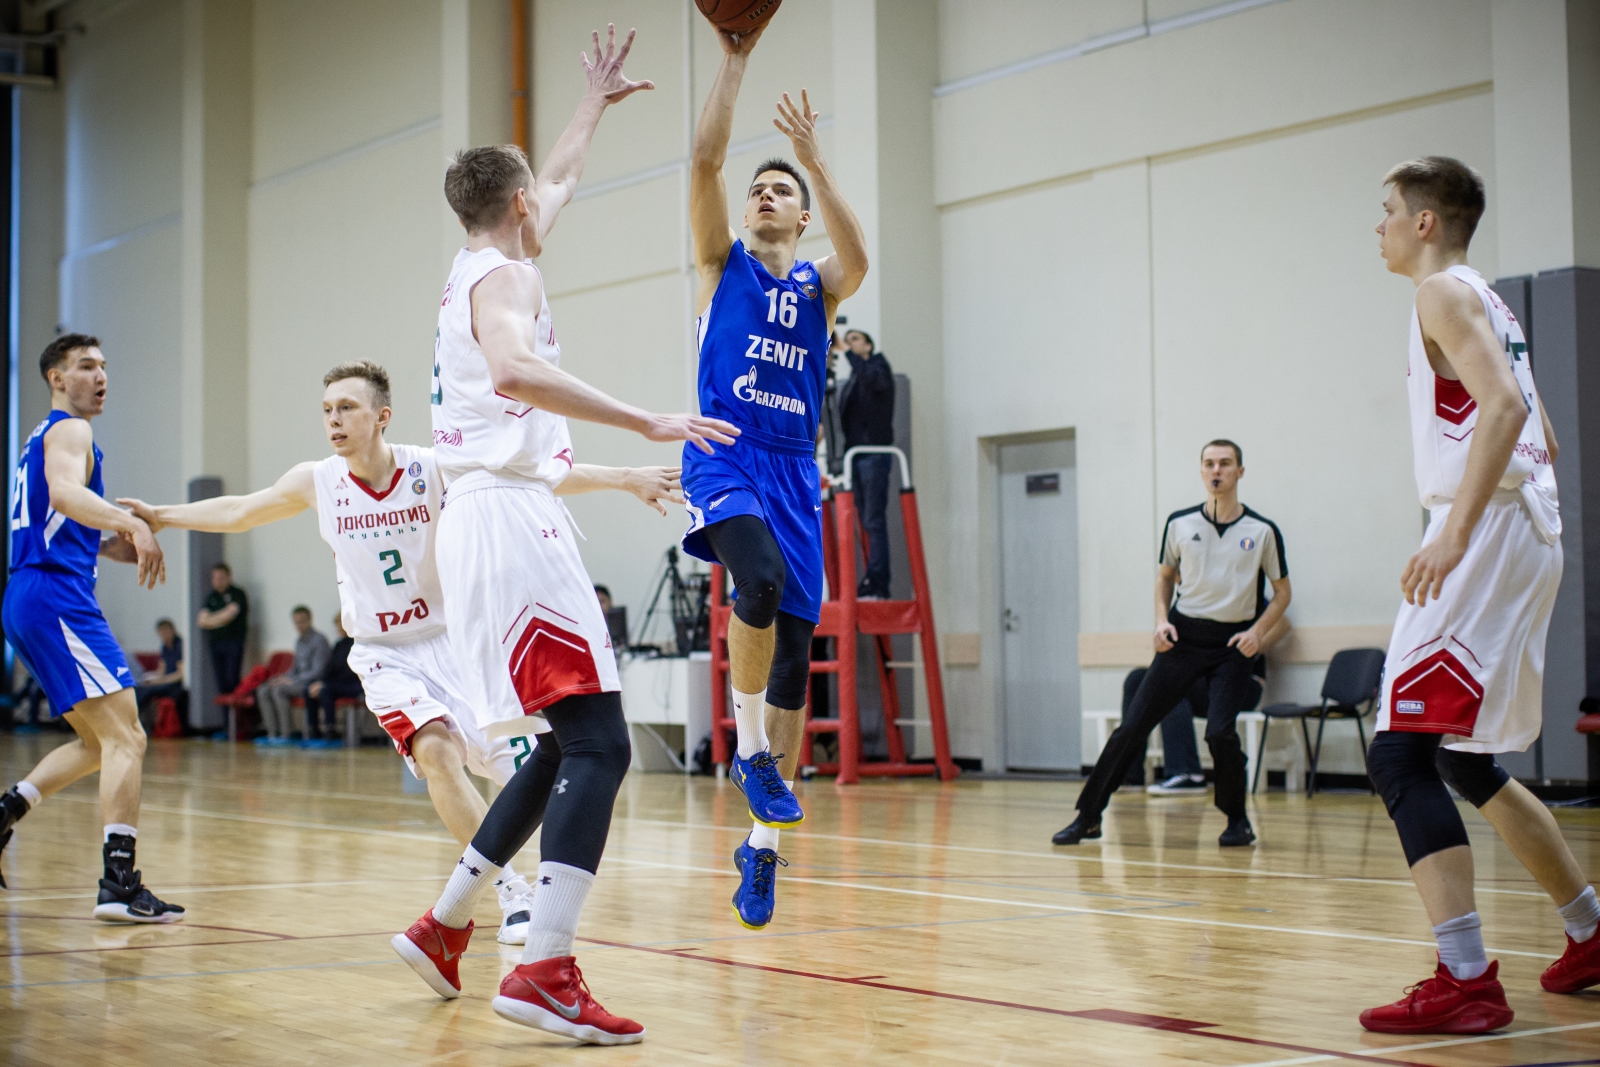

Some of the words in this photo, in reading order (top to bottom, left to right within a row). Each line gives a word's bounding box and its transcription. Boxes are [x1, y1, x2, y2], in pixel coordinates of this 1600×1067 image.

[764, 287, 798, 329] 16
[744, 334, 809, 372] ZENIT
[755, 389, 806, 416] GAZPROM
[336, 504, 431, 535] ЛОКОМОТИВ
[348, 525, 418, 540] КУБАНЬ
[378, 549, 406, 586] 2
[510, 735, 532, 771] 2
